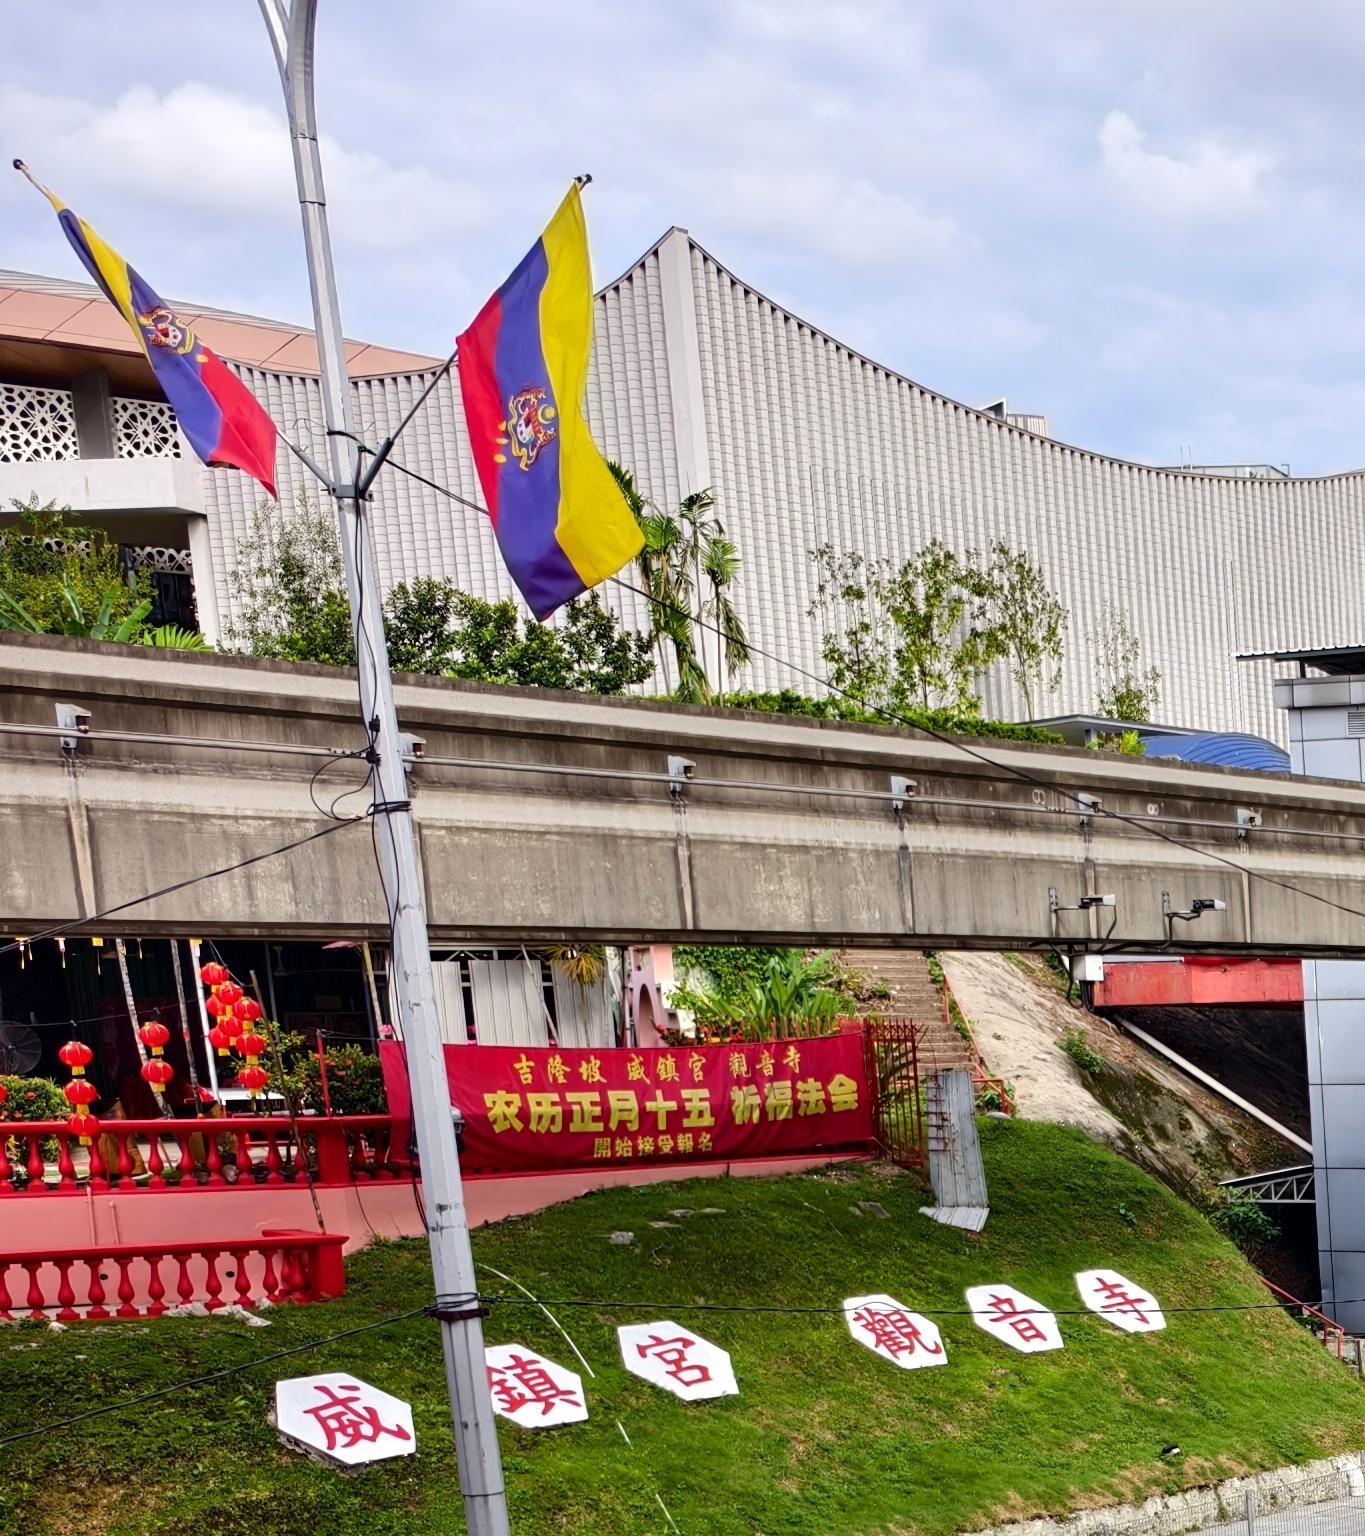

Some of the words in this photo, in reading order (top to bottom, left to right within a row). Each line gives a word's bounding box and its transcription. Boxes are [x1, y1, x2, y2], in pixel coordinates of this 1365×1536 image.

[513, 1053, 607, 1085] 吉隆坡
[483, 1089, 716, 1134] 农历正月十五
[731, 1074, 859, 1125] 祈福法会
[593, 1133, 714, 1159] 開始接受報名
[303, 1384, 411, 1451] 威
[486, 1354, 583, 1416] 鎮
[635, 1334, 713, 1387] 宮
[852, 1306, 943, 1361] 觀
[986, 1293, 1048, 1343] 音
[1092, 1277, 1150, 1325] 寺
